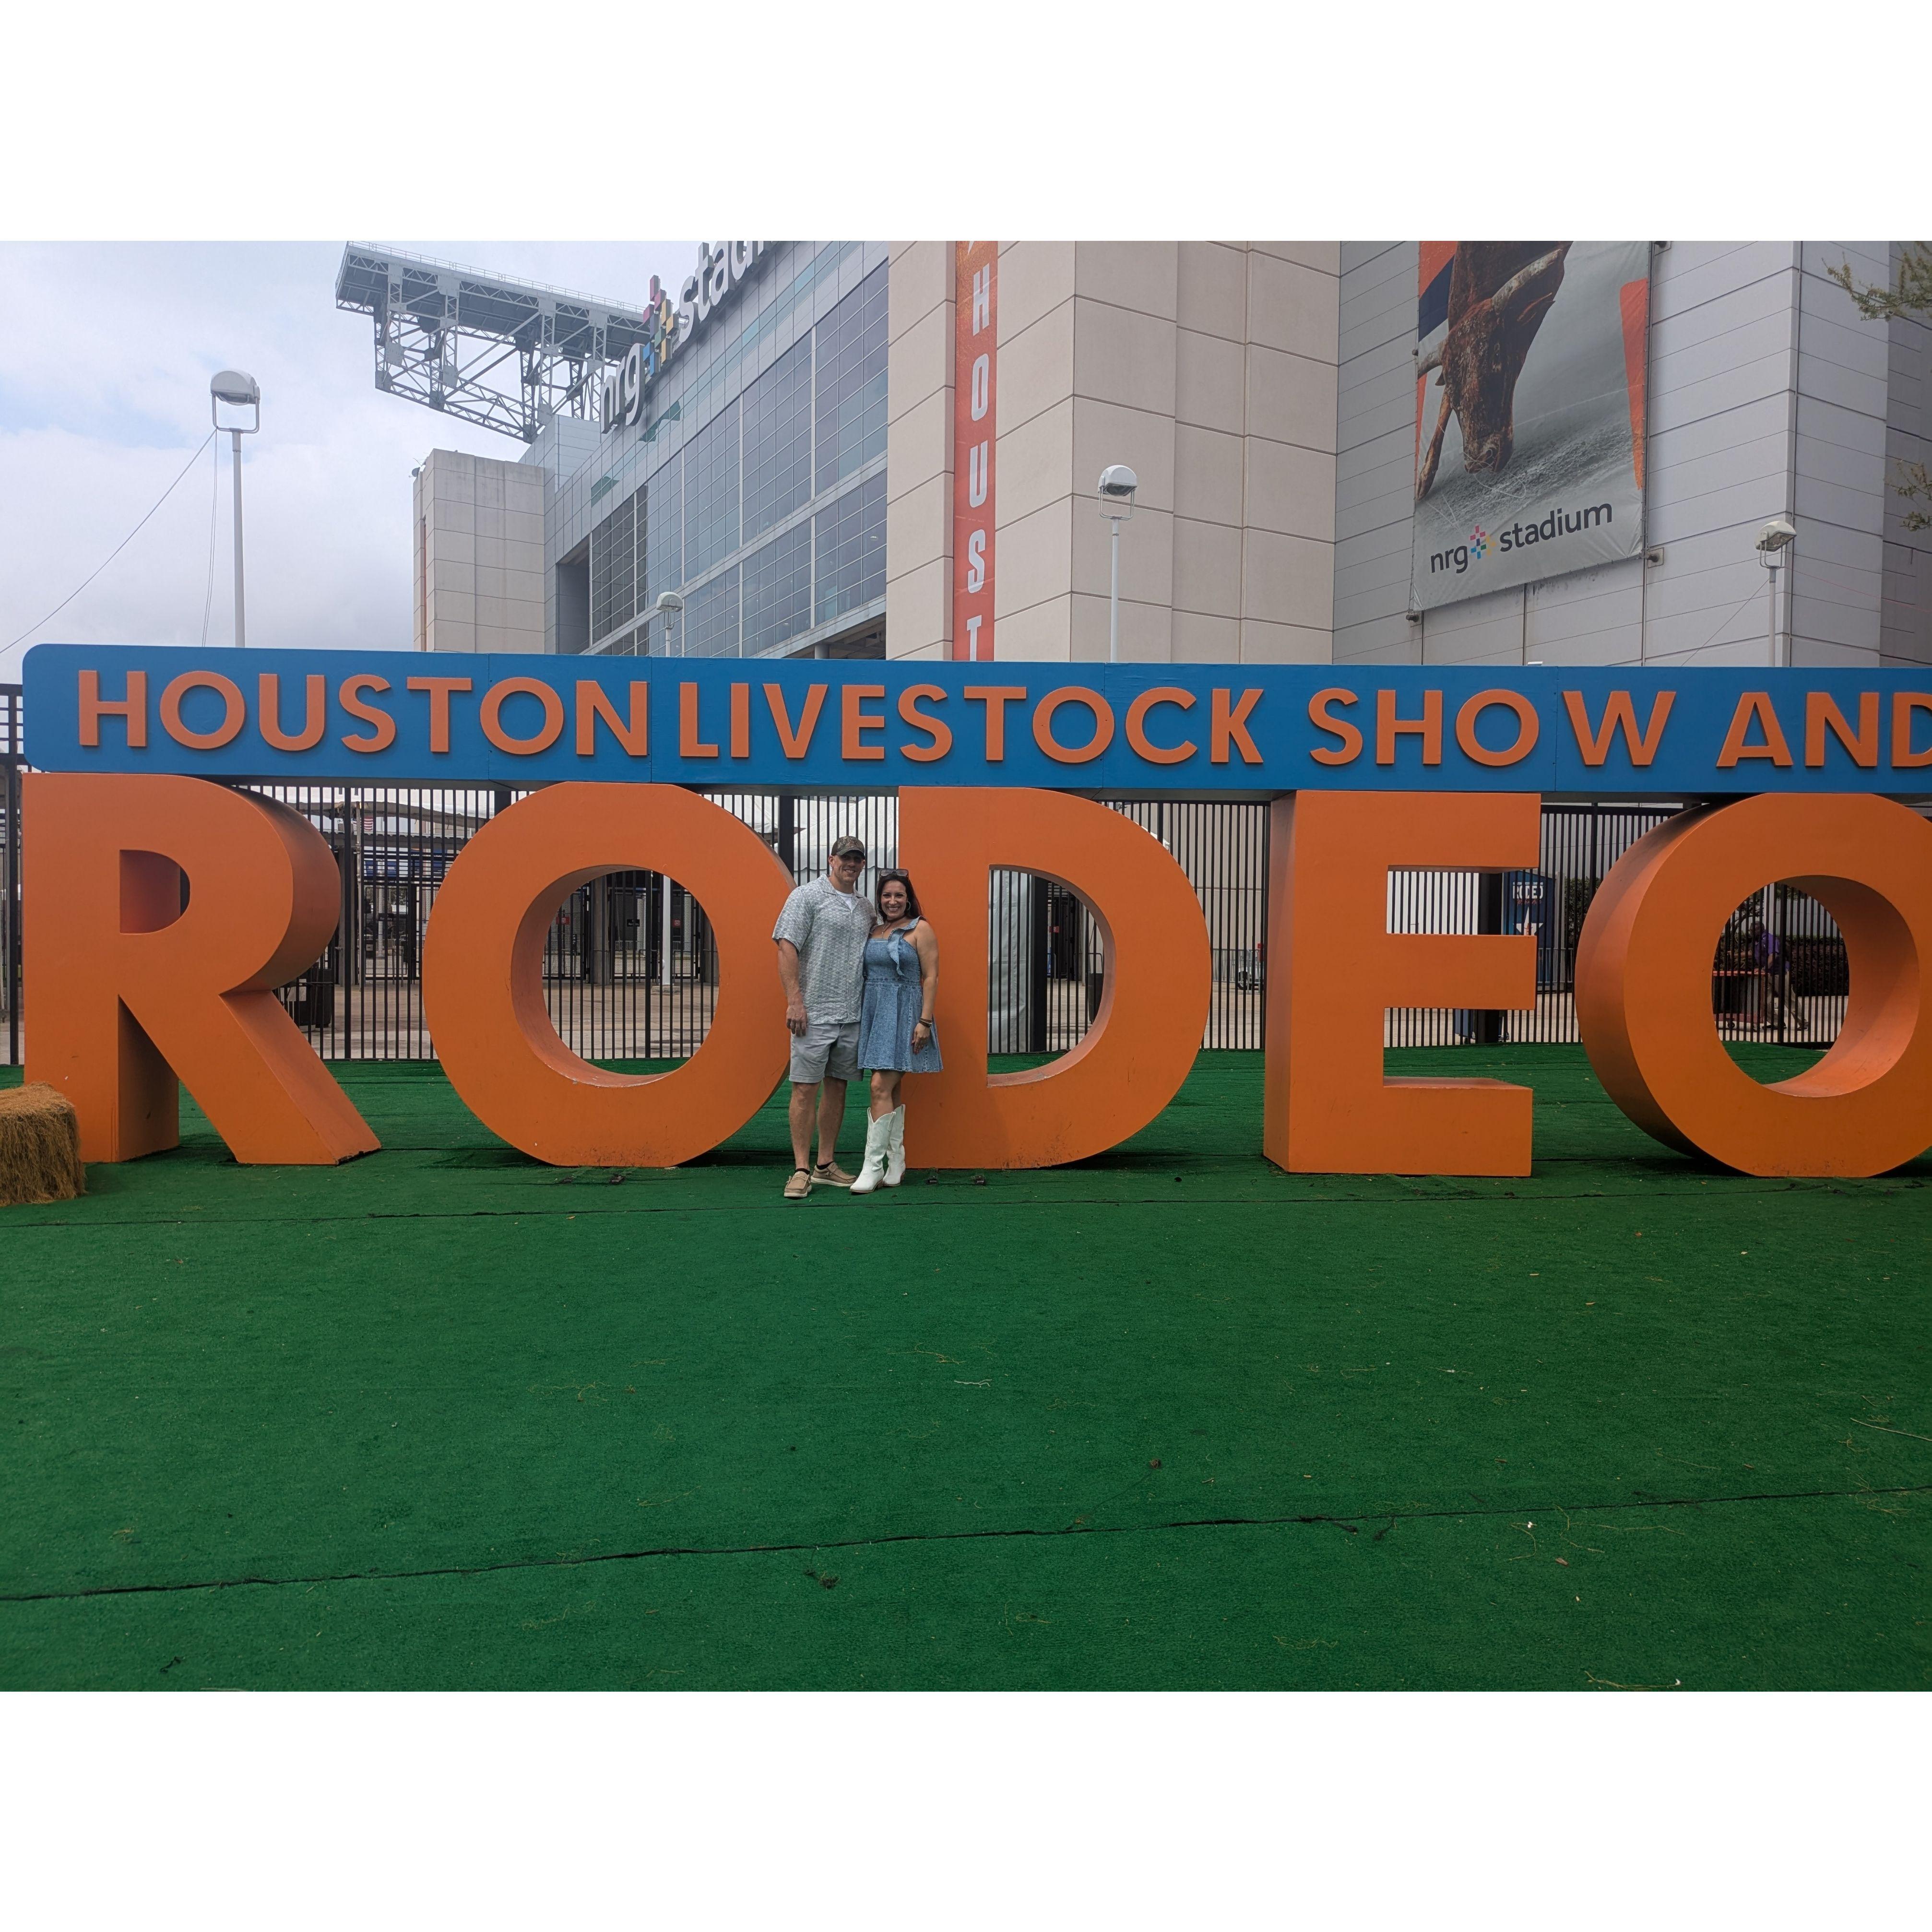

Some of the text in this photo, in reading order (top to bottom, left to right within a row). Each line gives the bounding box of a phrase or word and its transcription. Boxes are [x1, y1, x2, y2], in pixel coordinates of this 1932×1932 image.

[600, 241, 764, 434] nrg sta
[1430, 503, 1612, 574] nrg stadium
[79, 670, 649, 757] HOUSTON
[679, 682, 1265, 764] LIVESTOCK
[1308, 688, 1676, 767] SHOW
[22, 772, 1932, 1178] RODEO
